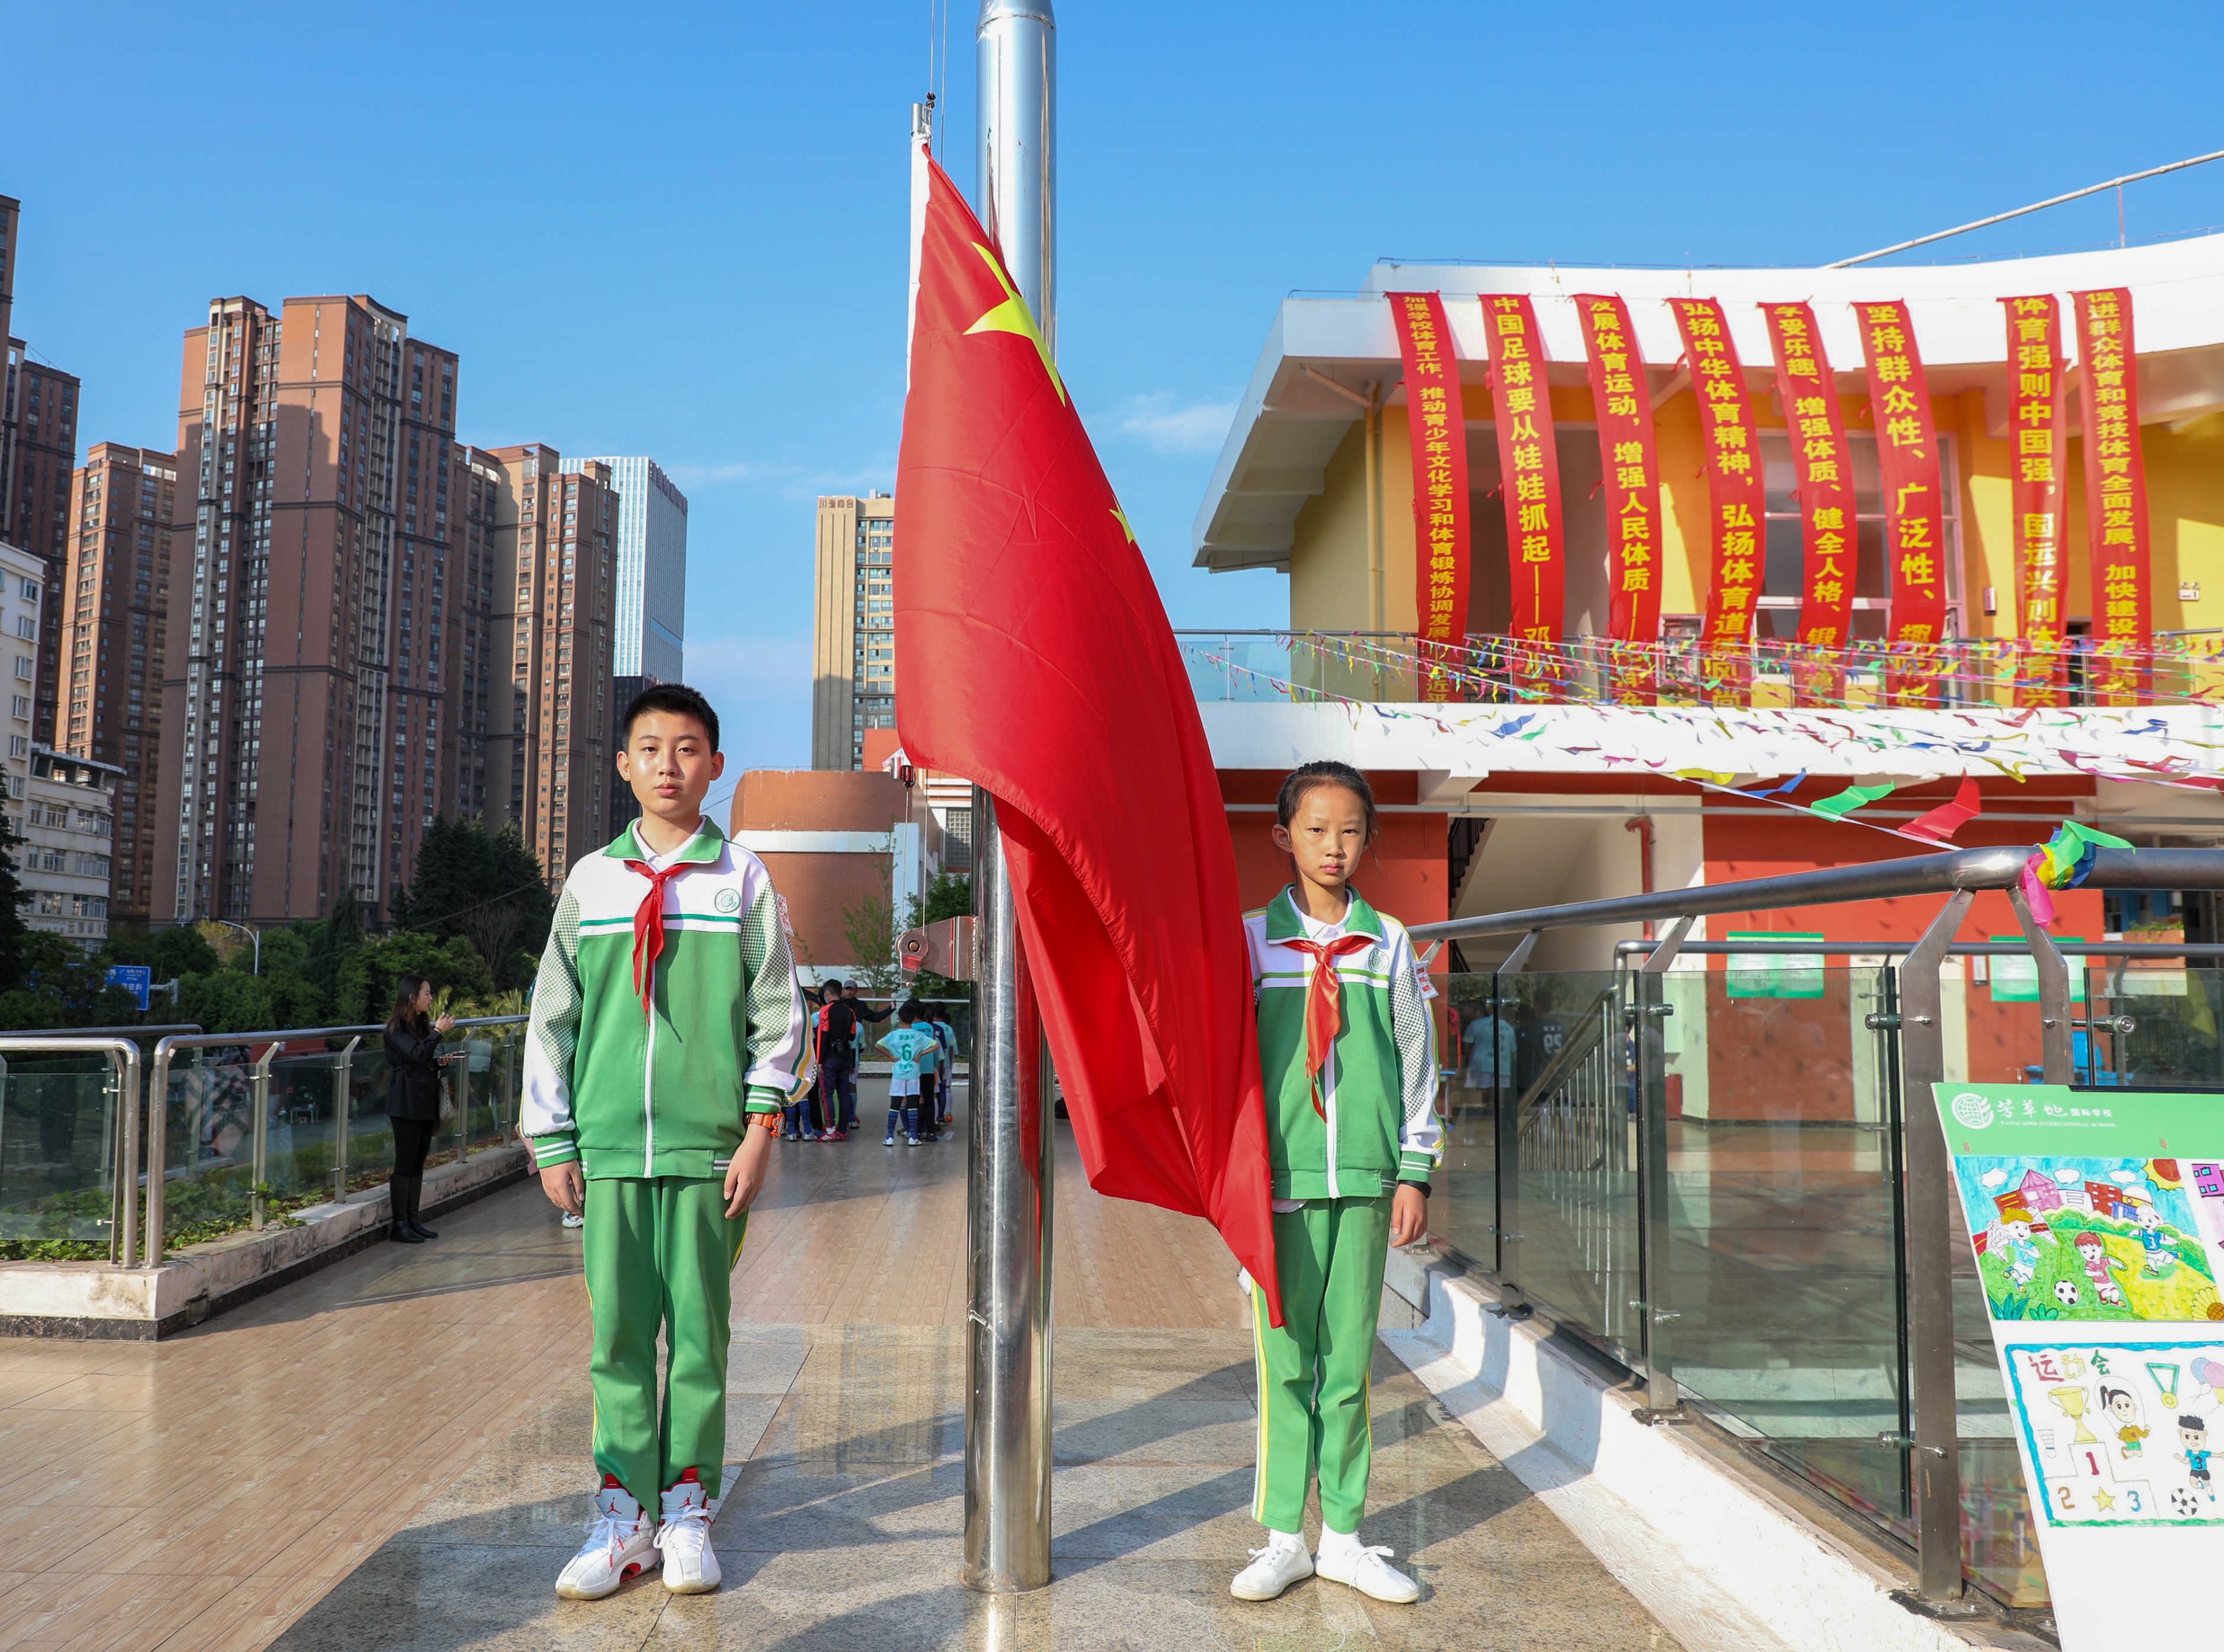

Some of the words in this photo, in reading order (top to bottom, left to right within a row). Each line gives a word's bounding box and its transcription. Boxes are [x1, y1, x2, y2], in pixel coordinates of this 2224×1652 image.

[902, 1043, 912, 1062] 6
[2149, 1238, 2156, 1249] 3
[2029, 1349, 2111, 1383] 运动会
[2085, 1451, 2100, 1477] 1
[2195, 1456, 2204, 1470] 3
[2058, 1486, 2075, 1510] 2
[2127, 1490, 2142, 1512] 3
